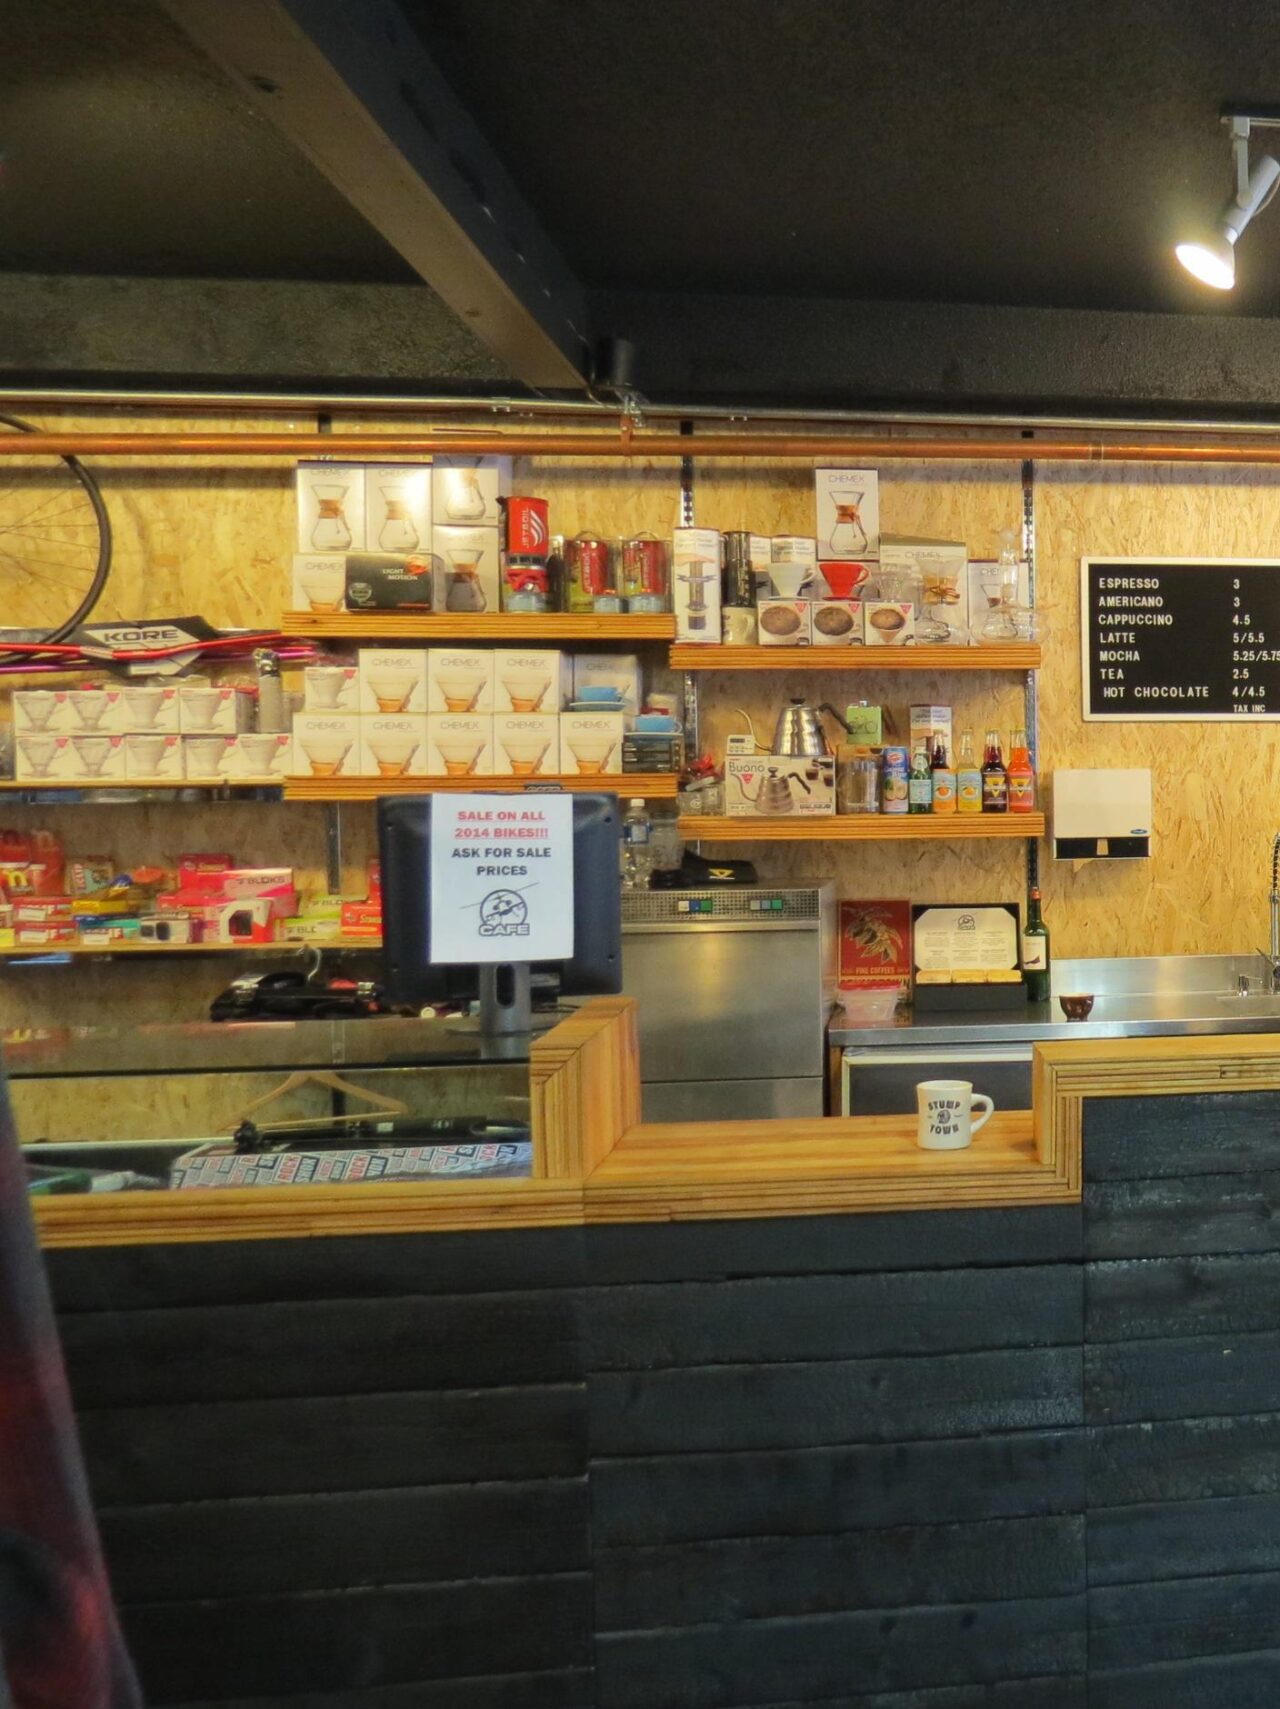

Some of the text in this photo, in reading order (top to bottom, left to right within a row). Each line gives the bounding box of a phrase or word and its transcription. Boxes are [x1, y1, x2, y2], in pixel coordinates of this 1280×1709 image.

[828, 474, 865, 483] CHEMEX
[520, 508, 530, 549] JETBOIL
[1099, 578, 1240, 589] ESPRESSO 3
[1099, 596, 1240, 607] AMERICANO 3
[1099, 614, 1250, 626] CAPPUCCINO 4.5
[105, 630, 178, 642] KORE
[1100, 632, 1265, 644] LATTE 5/5.5
[1100, 651, 1140, 661] MOCHA
[372, 658, 412, 667] CHEMEX
[440, 658, 480, 667] CHEMEX
[507, 658, 546, 667] CHEMEX
[1100, 668, 1250, 679] TEA 2.5
[1103, 687, 1126, 698] HOT
[1134, 686, 1209, 698] CHOCOLATE
[1233, 704, 1266, 713] TAX INC
[306, 721, 346, 730] CHEMEX
[373, 721, 413, 730] CHEMEX
[440, 721, 480, 730] CHEMEX
[505, 720, 544, 729] CHEMEX
[571, 720, 610, 729] CHEMEX
[729, 761, 766, 773] Buono
[457, 811, 544, 821] SALE ON ALL
[455, 828, 548, 838] 2014 BIKES!!!
[452, 848, 551, 858] ASK FOR SALE
[477, 866, 528, 875] PRICES
[479, 923, 530, 936] CAFE
[928, 1100, 961, 1111] STUMP
[930, 1122, 960, 1135] TOWN
